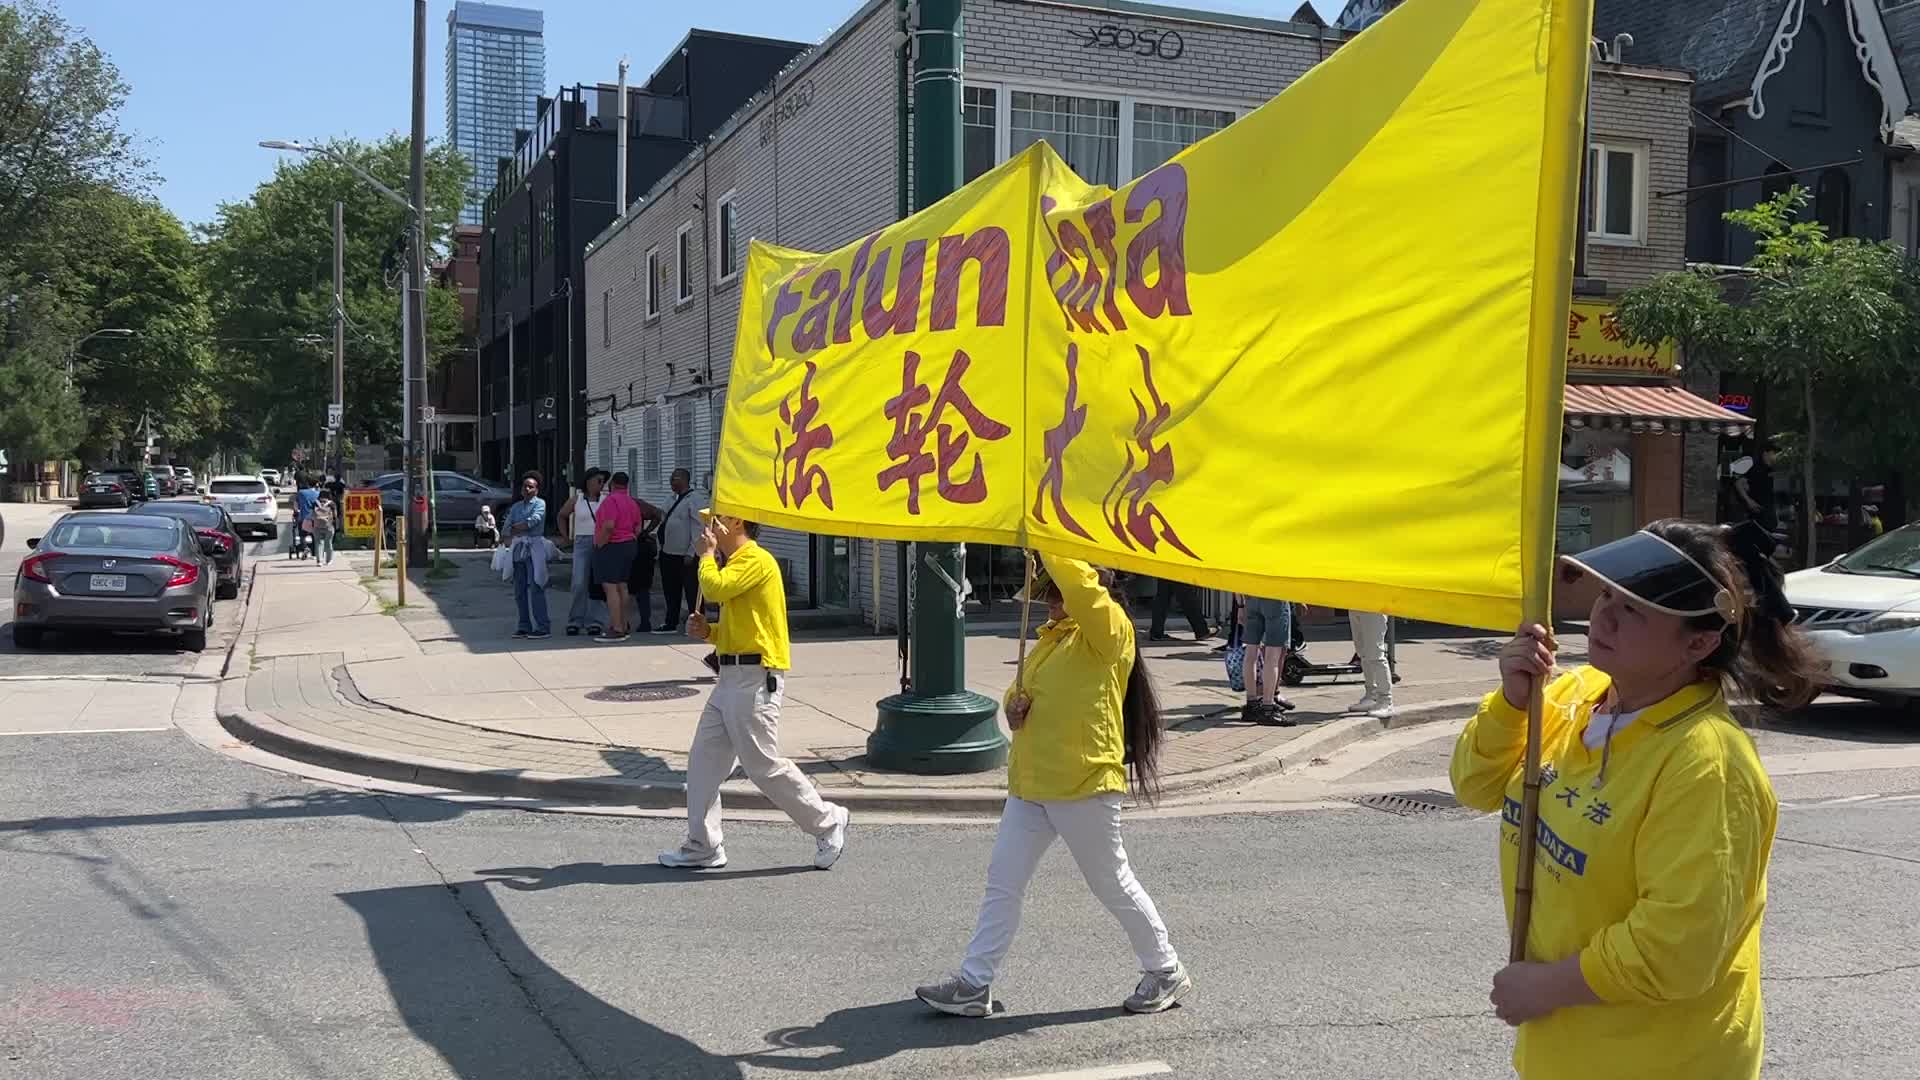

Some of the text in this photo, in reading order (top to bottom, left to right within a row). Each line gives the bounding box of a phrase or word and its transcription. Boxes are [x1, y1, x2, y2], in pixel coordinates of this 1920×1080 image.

[767, 226, 1010, 361] Falun
[345, 513, 376, 527] TAX
[1543, 831, 1578, 871] DAFA
